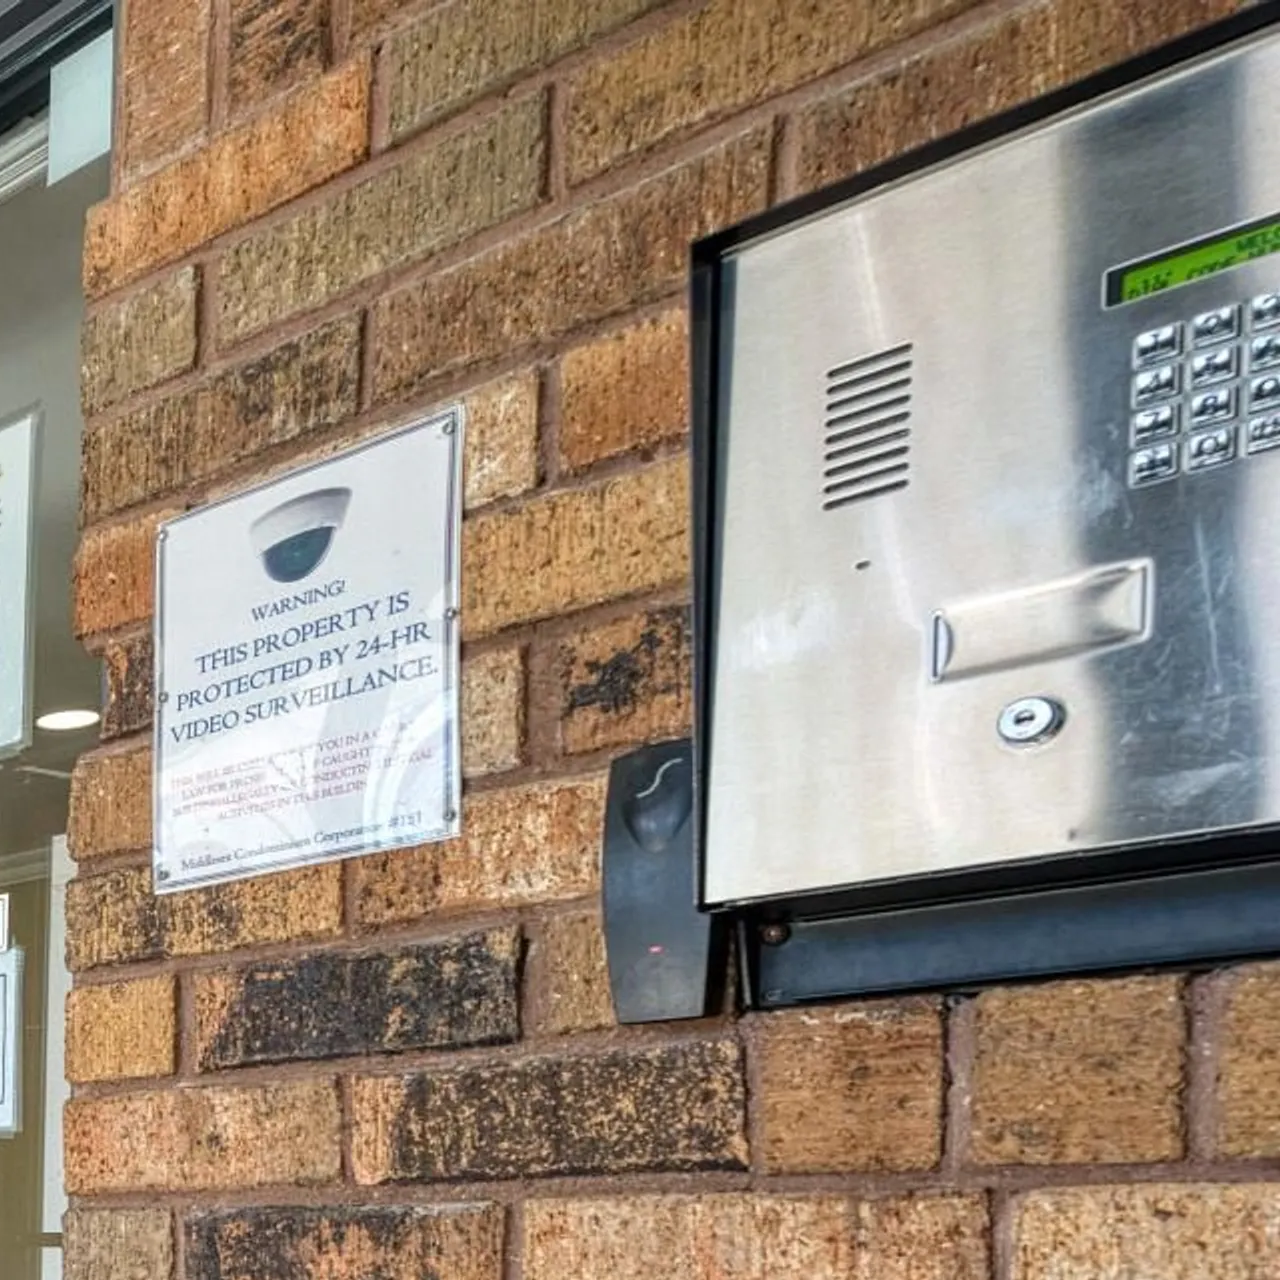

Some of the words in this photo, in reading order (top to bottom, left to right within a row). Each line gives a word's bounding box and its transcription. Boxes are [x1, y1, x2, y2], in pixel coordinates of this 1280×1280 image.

[195, 642, 248, 675] THIS
[253, 602, 380, 656] PROPERTY
[387, 591, 410, 615] IS
[250, 580, 346, 623] WARNING!
[170, 709, 241, 744] VIDEO
[244, 657, 440, 728] SURVEILLANCE.
[176, 661, 316, 712] PROTECTED
[319, 650, 350, 675] BY
[356, 622, 432, 662] 24-HR
[318, 738, 344, 752] YOU
[345, 733, 360, 746] IN
